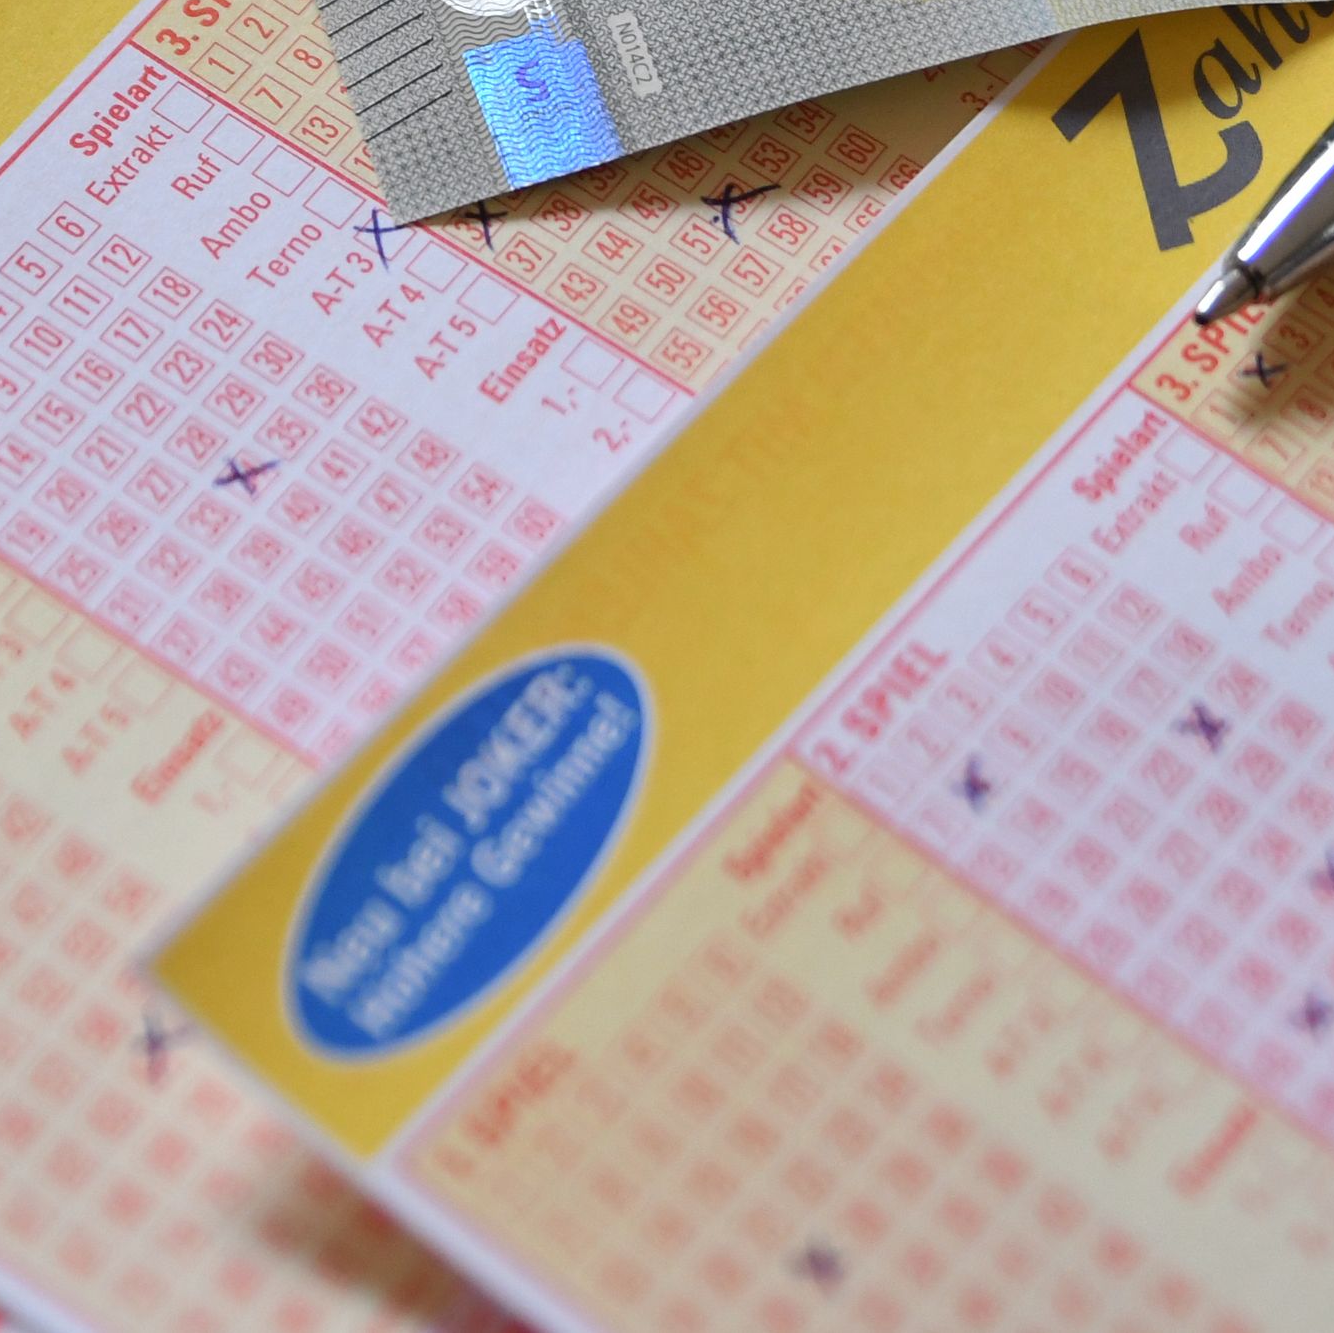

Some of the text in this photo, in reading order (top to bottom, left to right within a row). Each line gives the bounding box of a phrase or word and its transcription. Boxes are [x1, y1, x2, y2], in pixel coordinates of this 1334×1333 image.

[156, 21, 200, 56] 3.
[242, 16, 275, 40] 2
[609, 13, 654, 91] N014C2
[70, 63, 167, 157] Spielart
[254, 86, 284, 110] 7
[301, 115, 340, 145] 13
[85, 122, 174, 206] Extrakt
[171, 153, 222, 201] Ruf
[15, 215, 86, 280] 5 6
[200, 191, 272, 260] Ambo
[246, 222, 323, 289] Terno
[767, 212, 809, 246] 58
[101, 242, 142, 274] 12
[311, 251, 375, 316] A-T 3
[645, 262, 686, 295] 50
[152, 275, 192, 306] 18
[362, 284, 425, 348] A-T 4
[414, 316, 477, 380] A-T 5
[478, 318, 566, 404] Einsatz
[1155, 373, 1199, 402] 3.
[1072, 411, 1167, 503] Spielart
[1092, 471, 1178, 555] Extrakt
[1179, 503, 1230, 553] Ruf
[842, 640, 952, 741] SPIEL
